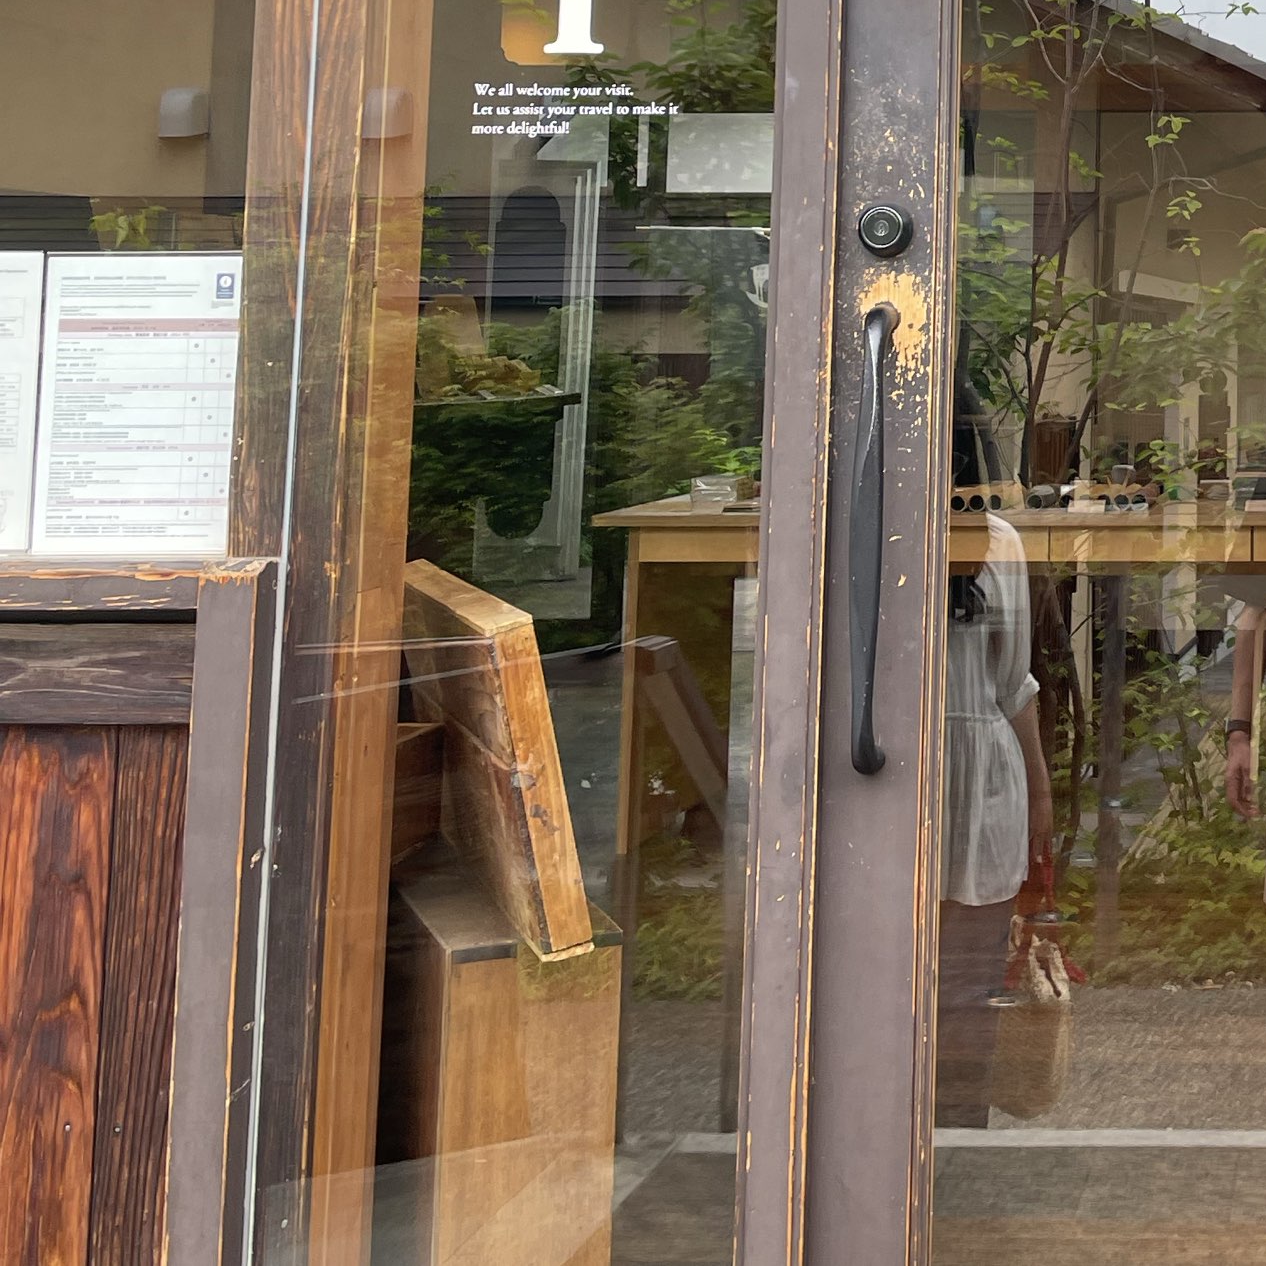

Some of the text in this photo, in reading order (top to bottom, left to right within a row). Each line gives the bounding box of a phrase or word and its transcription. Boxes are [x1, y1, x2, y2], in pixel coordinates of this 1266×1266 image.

[475, 83, 634, 100] We all welcome your visit.
[473, 102, 679, 119] Let us assist your travel to make it
[472, 121, 570, 138] more delightful!
